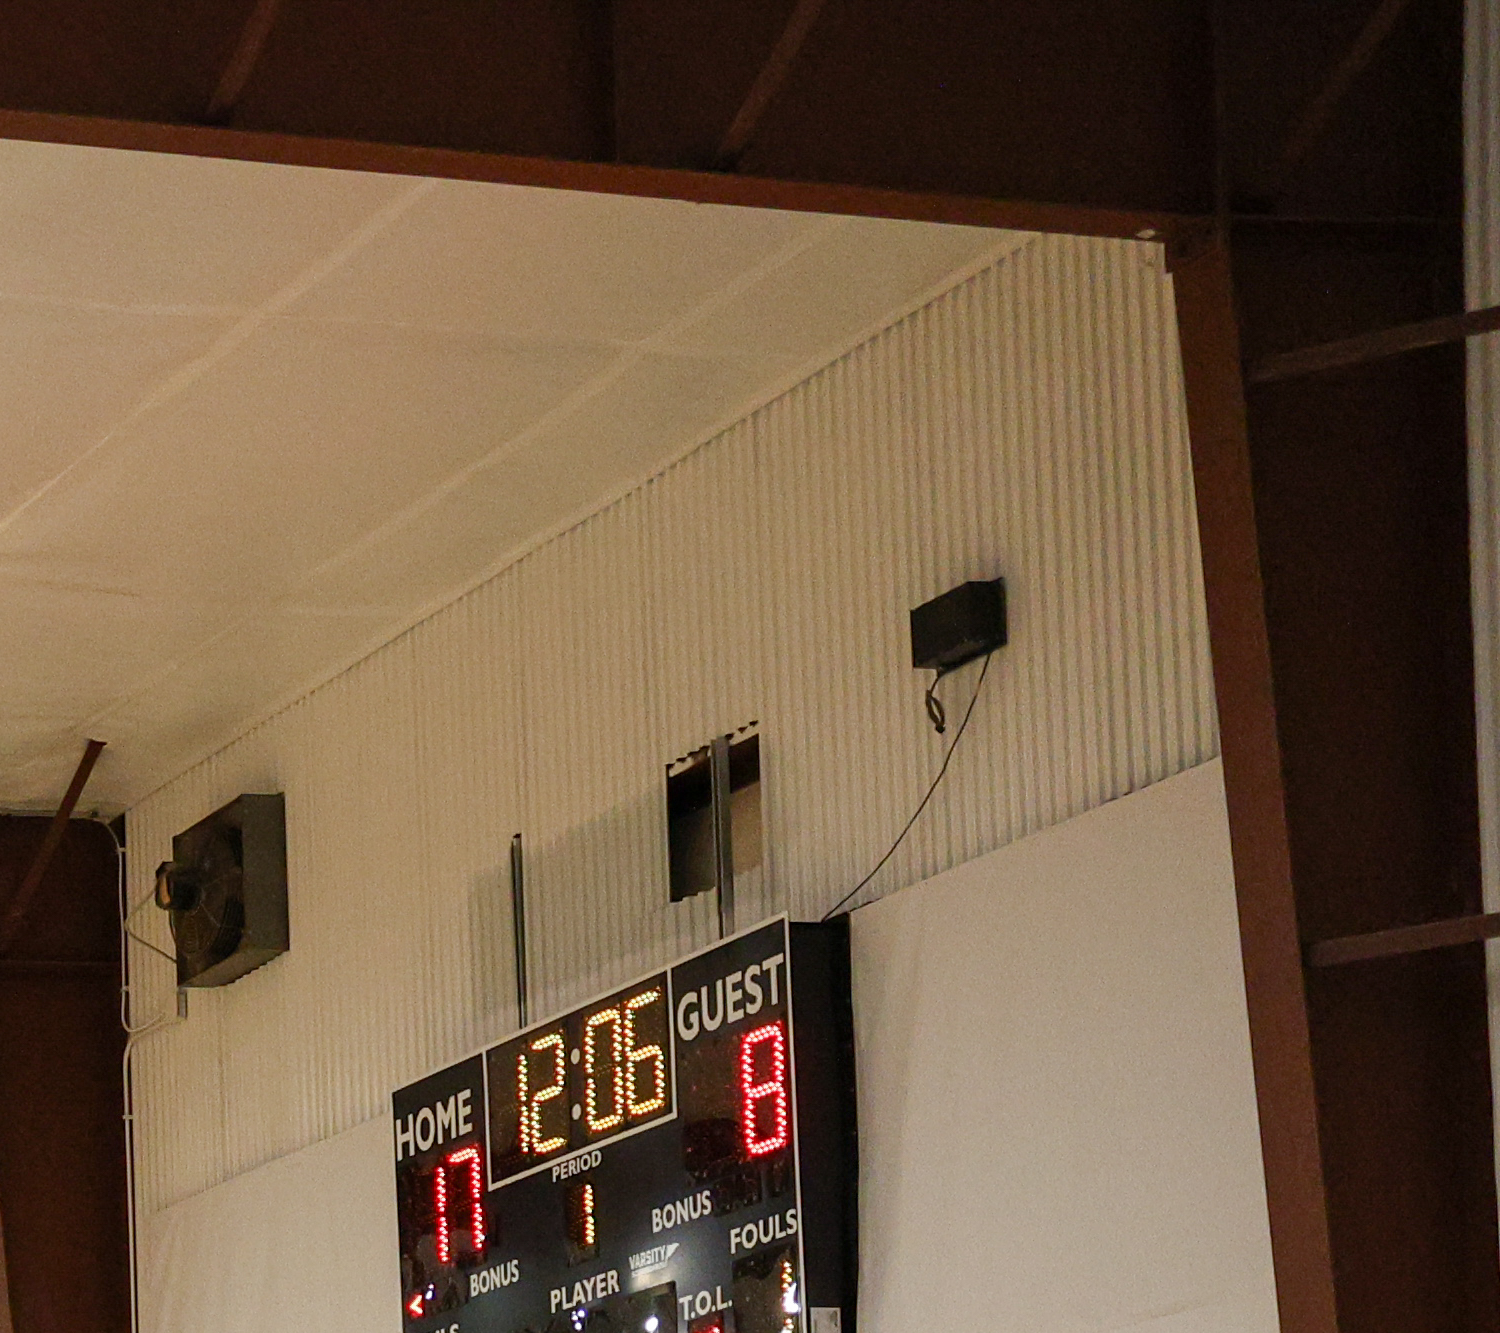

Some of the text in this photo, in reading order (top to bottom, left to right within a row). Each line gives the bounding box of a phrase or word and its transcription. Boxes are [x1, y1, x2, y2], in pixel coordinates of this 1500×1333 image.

[677, 954, 784, 1041] GUEST
[517, 986, 666, 1155] 12:06
[741, 1021, 788, 1156] 8
[396, 1089, 473, 1161] HOME
[552, 1151, 601, 1182] PERIOD
[435, 1147, 486, 1263] 17
[583, 1183, 595, 1246] 1
[651, 1190, 712, 1232] BONUS
[730, 1209, 798, 1255] FOULS
[470, 1259, 519, 1297] BONUS
[629, 1245, 666, 1270] VARSITY
[550, 1270, 620, 1314] PLAYER
[679, 1286, 733, 1321] T.O.L.
